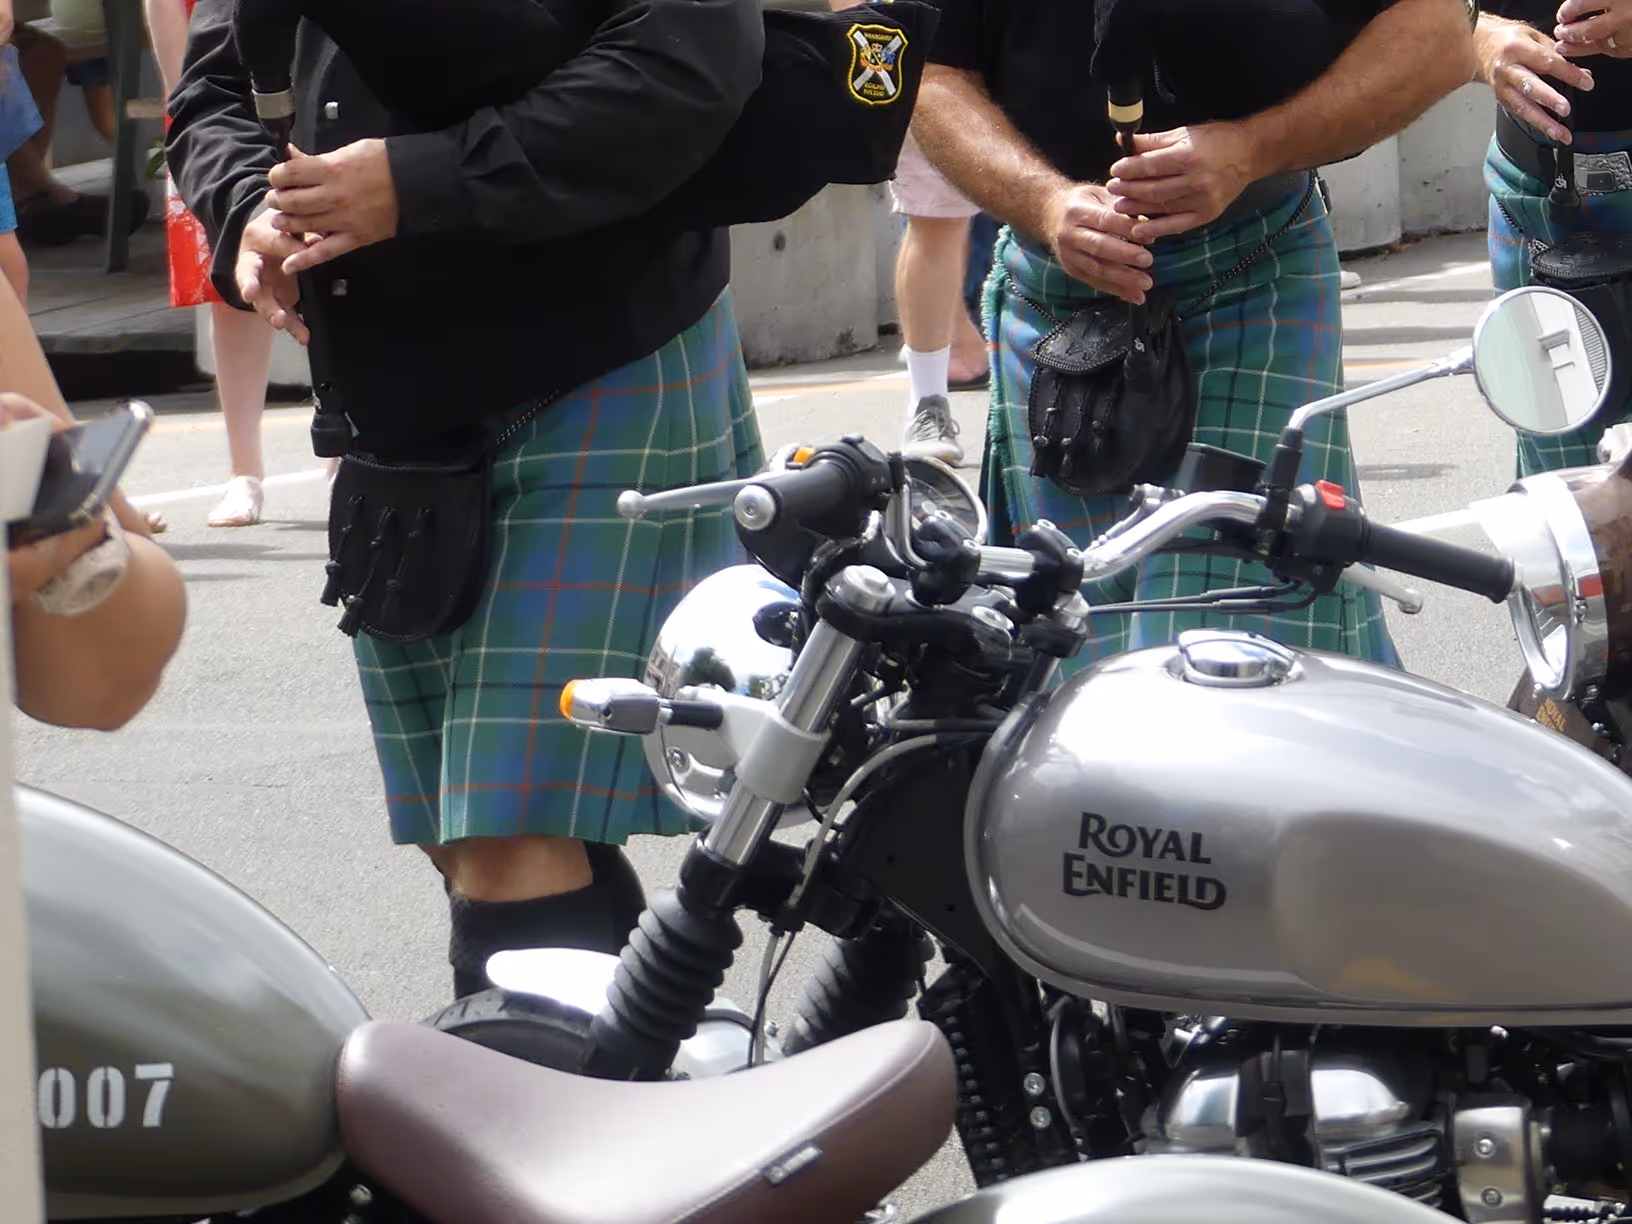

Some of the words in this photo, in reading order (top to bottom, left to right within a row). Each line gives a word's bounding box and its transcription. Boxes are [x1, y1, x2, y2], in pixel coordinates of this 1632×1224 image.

[1078, 811, 1212, 864] ROYAL
[1062, 852, 1227, 910] ENFIELD
[38, 1062, 174, 1128] 007
